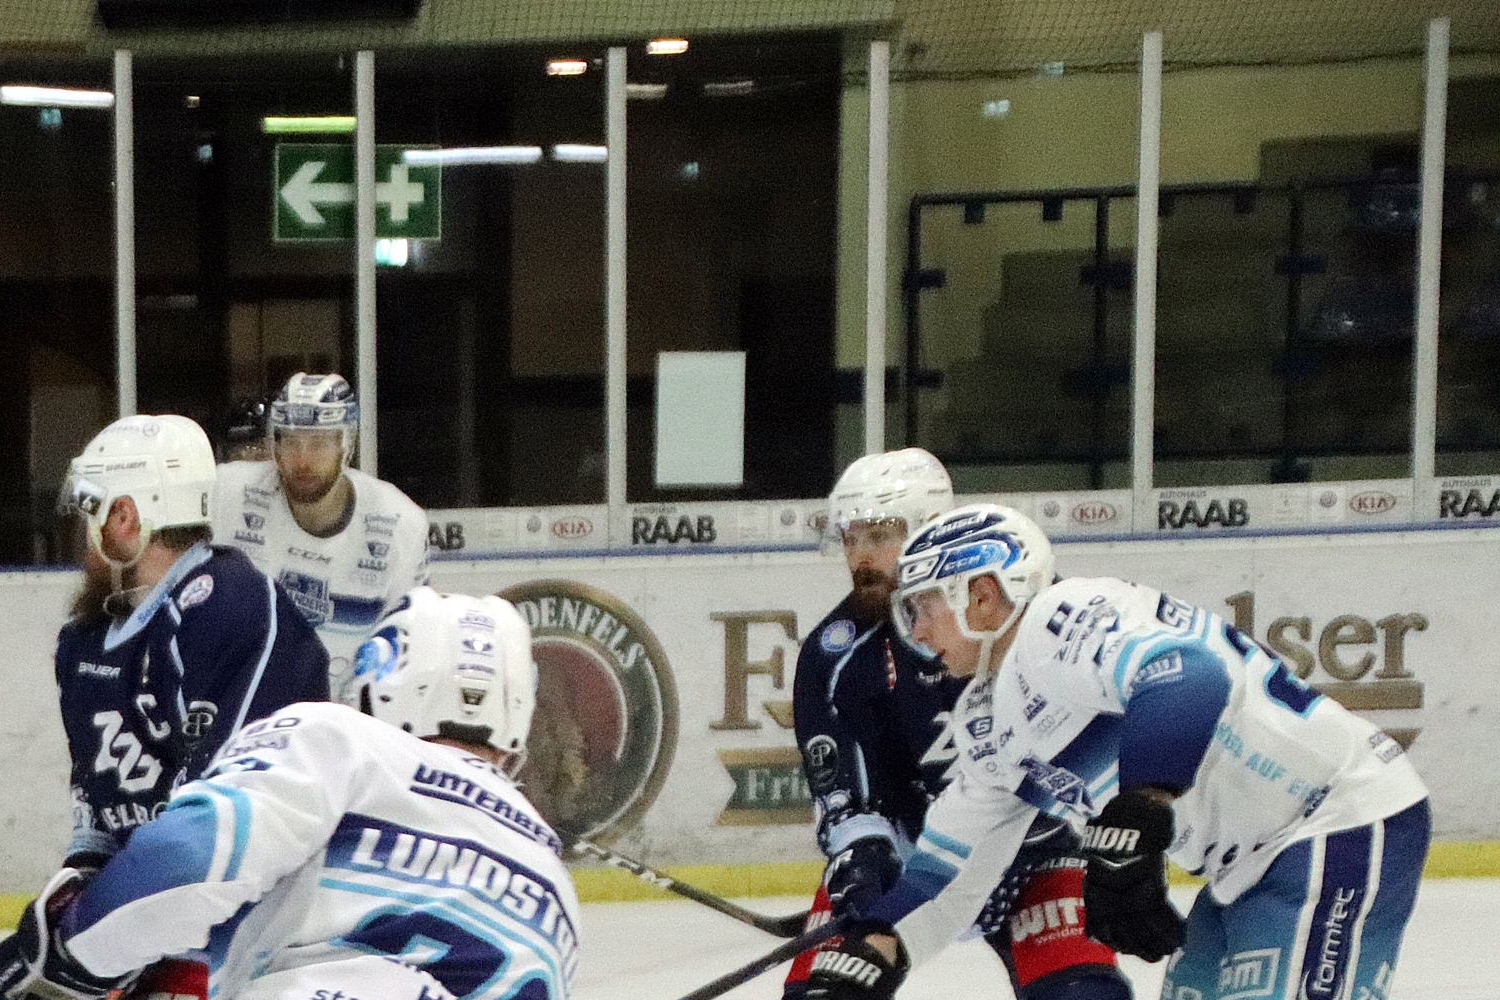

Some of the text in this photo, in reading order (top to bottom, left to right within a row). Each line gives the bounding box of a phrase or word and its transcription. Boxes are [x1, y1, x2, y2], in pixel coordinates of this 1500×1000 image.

[1159, 499, 1250, 530] RAAB
[1438, 488, 1500, 519] RAA
[428, 521, 466, 551] AB
[632, 515, 717, 545] RAAB
[518, 597, 647, 669] DENFELS
[744, 768, 812, 801] Fri
[1011, 895, 1085, 943] WIT
[1313, 887, 1355, 993] formtec
